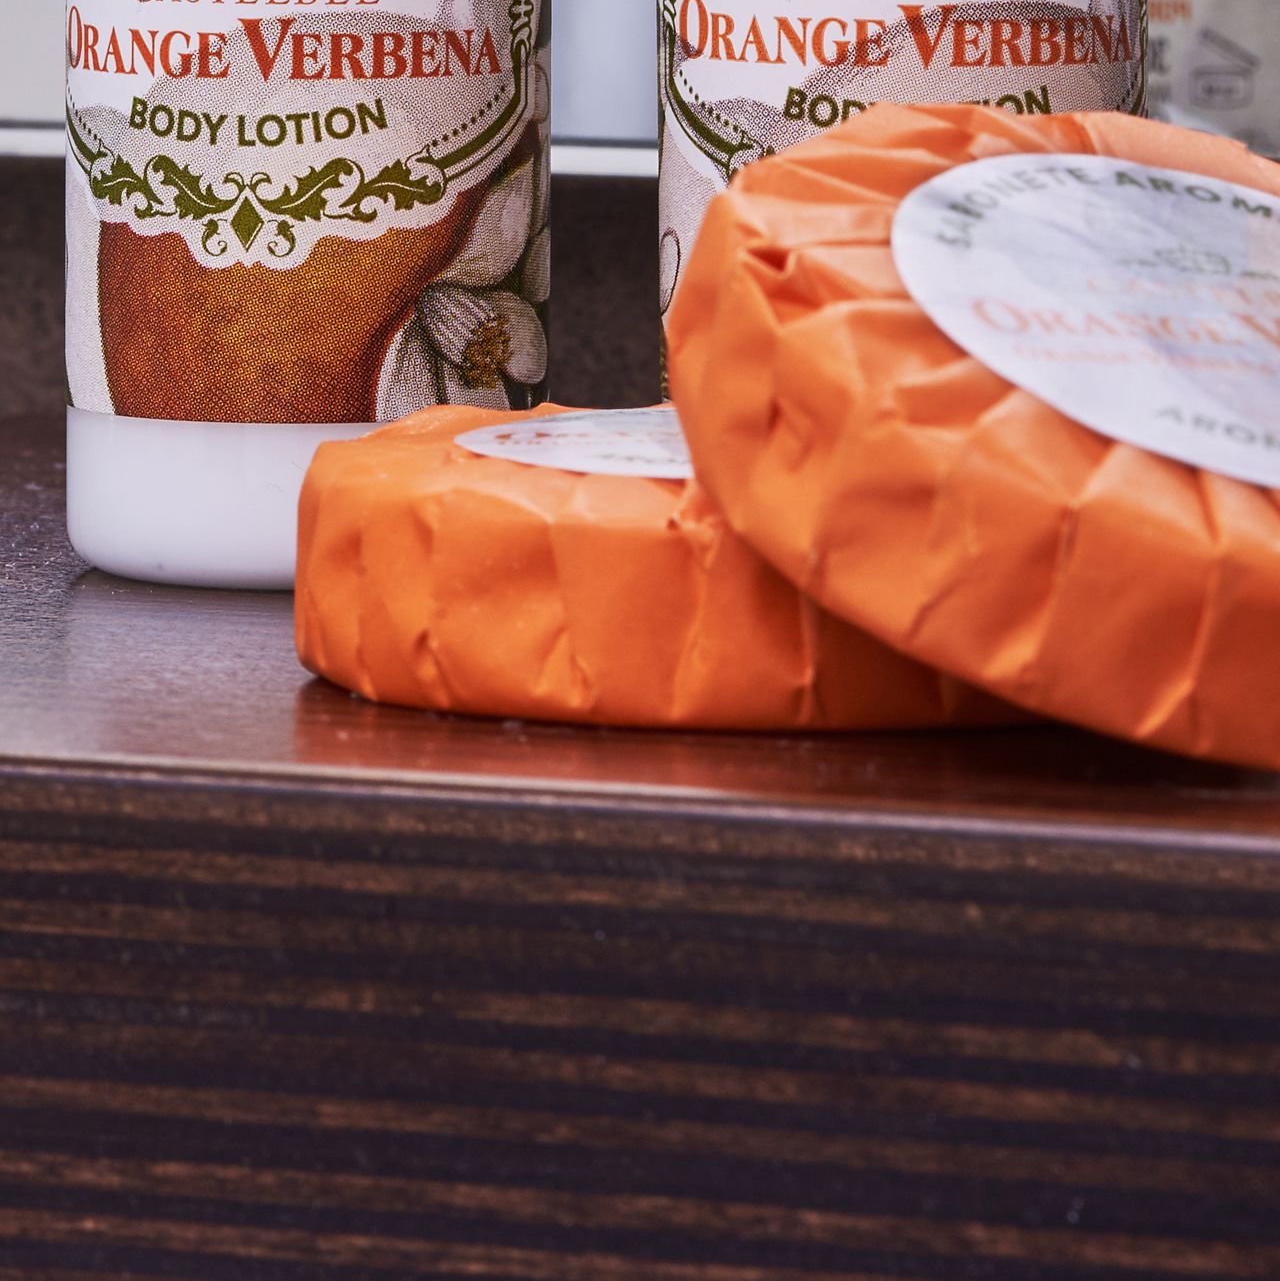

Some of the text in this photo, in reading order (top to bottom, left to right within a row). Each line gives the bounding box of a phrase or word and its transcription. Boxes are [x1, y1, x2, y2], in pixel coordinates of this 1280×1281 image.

[67, 5, 502, 83] ORANGE VERBENA
[897, 4, 1132, 71] VERBENA
[128, 96, 389, 148] BODY LOTION
[783, 86, 875, 128] BOD
